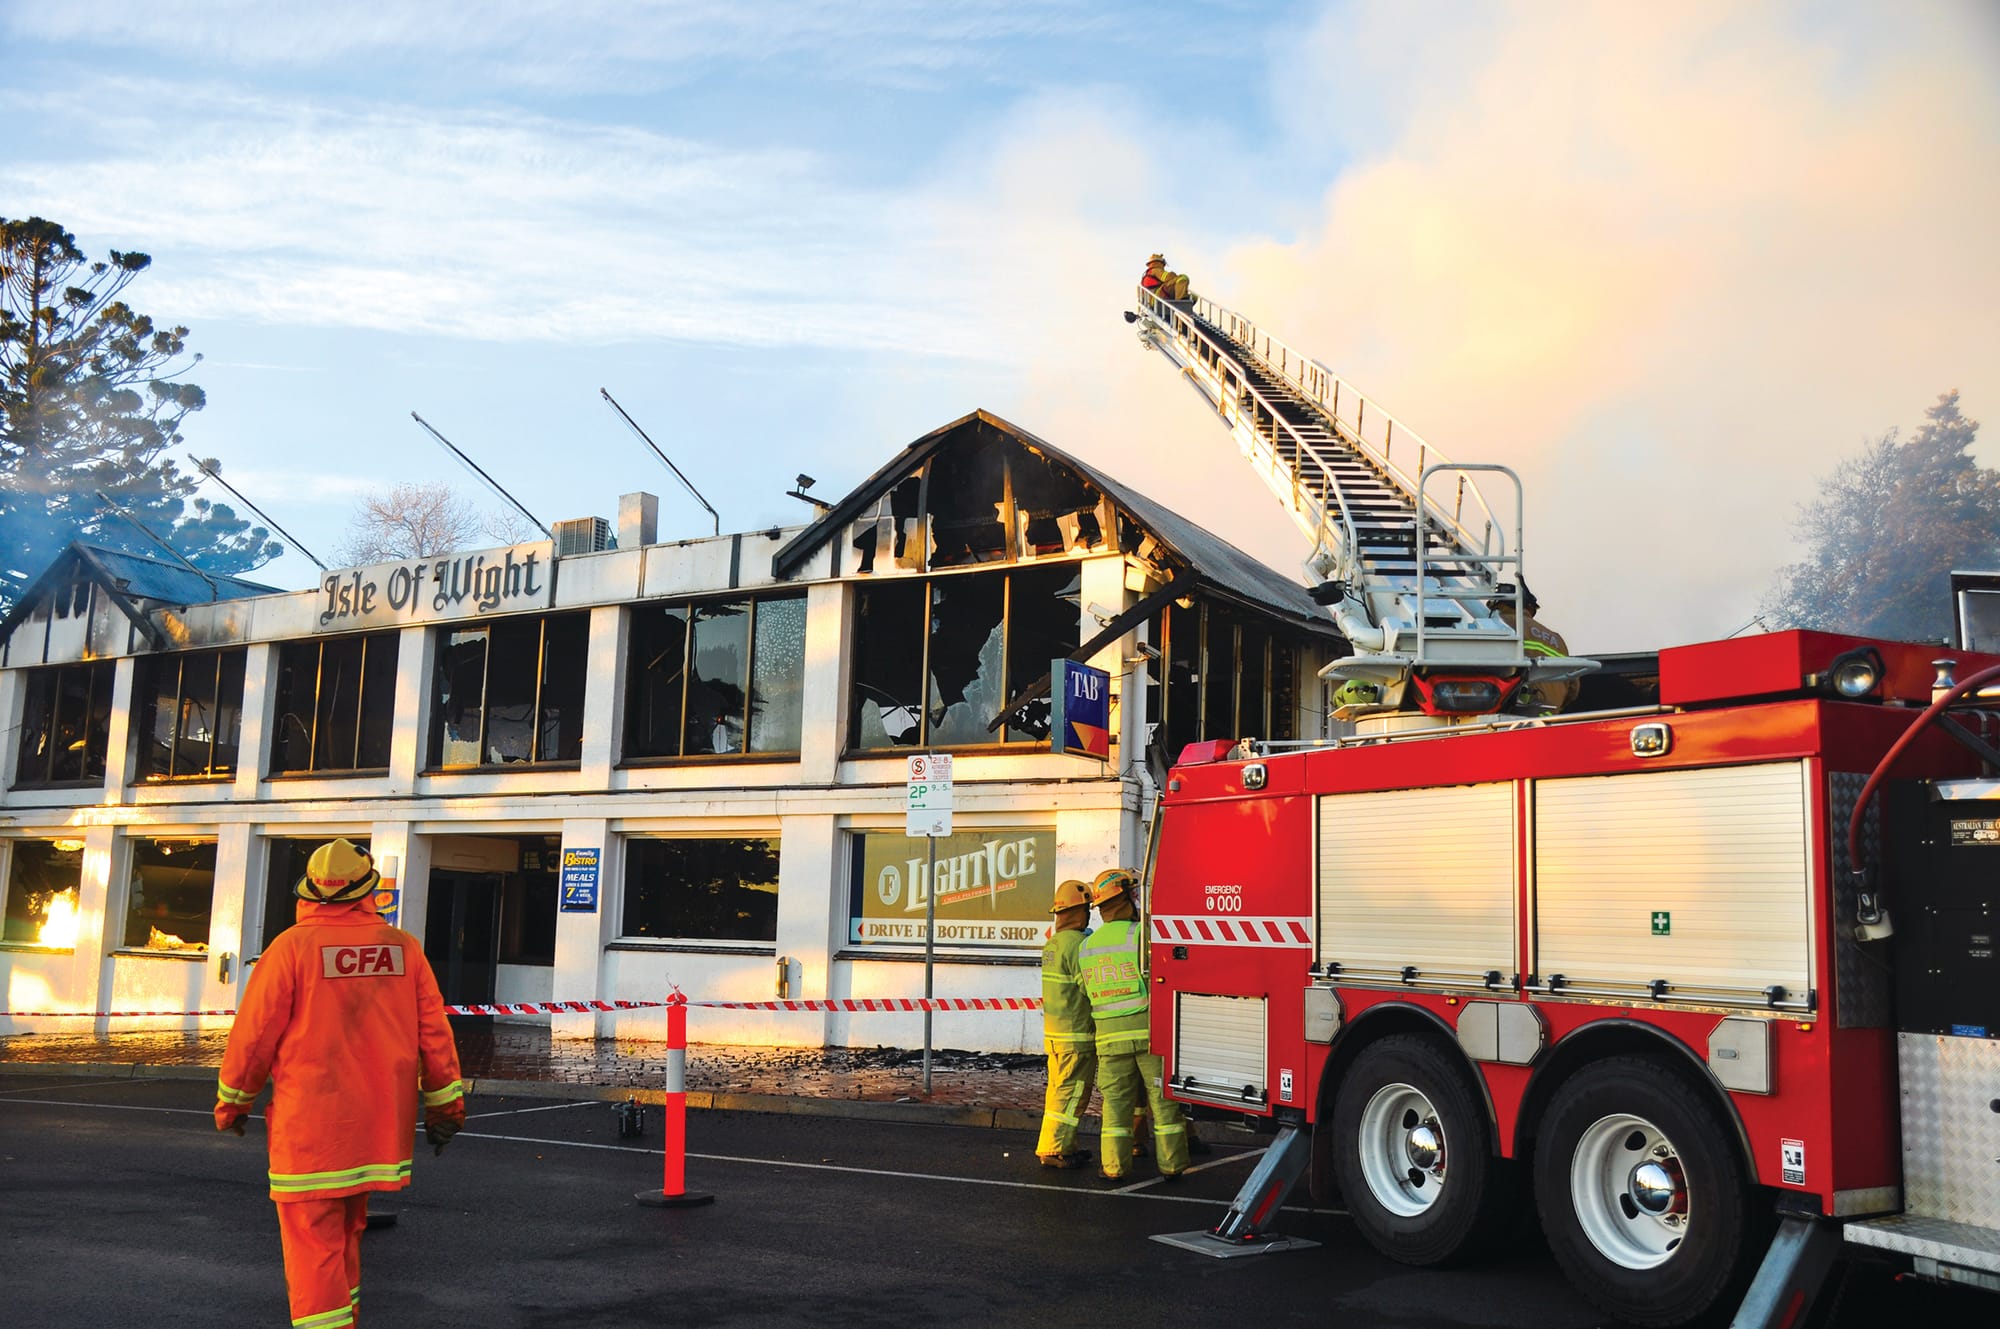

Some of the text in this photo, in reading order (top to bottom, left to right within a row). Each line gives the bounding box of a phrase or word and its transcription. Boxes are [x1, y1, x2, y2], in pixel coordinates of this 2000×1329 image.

[320, 549, 542, 626] Isle Of Wight
[1071, 671, 1099, 701] TAB
[909, 785, 928, 799] 2P
[564, 852, 597, 867] BISTRO
[565, 873, 596, 882] MEALS
[566, 887, 576, 898] 7
[1205, 885, 1242, 895] EMERGENCY
[1217, 895, 1242, 912] 000
[869, 924, 913, 938] DRIVE
[937, 925, 996, 940] BOTTLE
[1000, 927, 1039, 941] SHOP
[335, 947, 394, 975] CFA
[1083, 961, 1139, 986] FIRE
